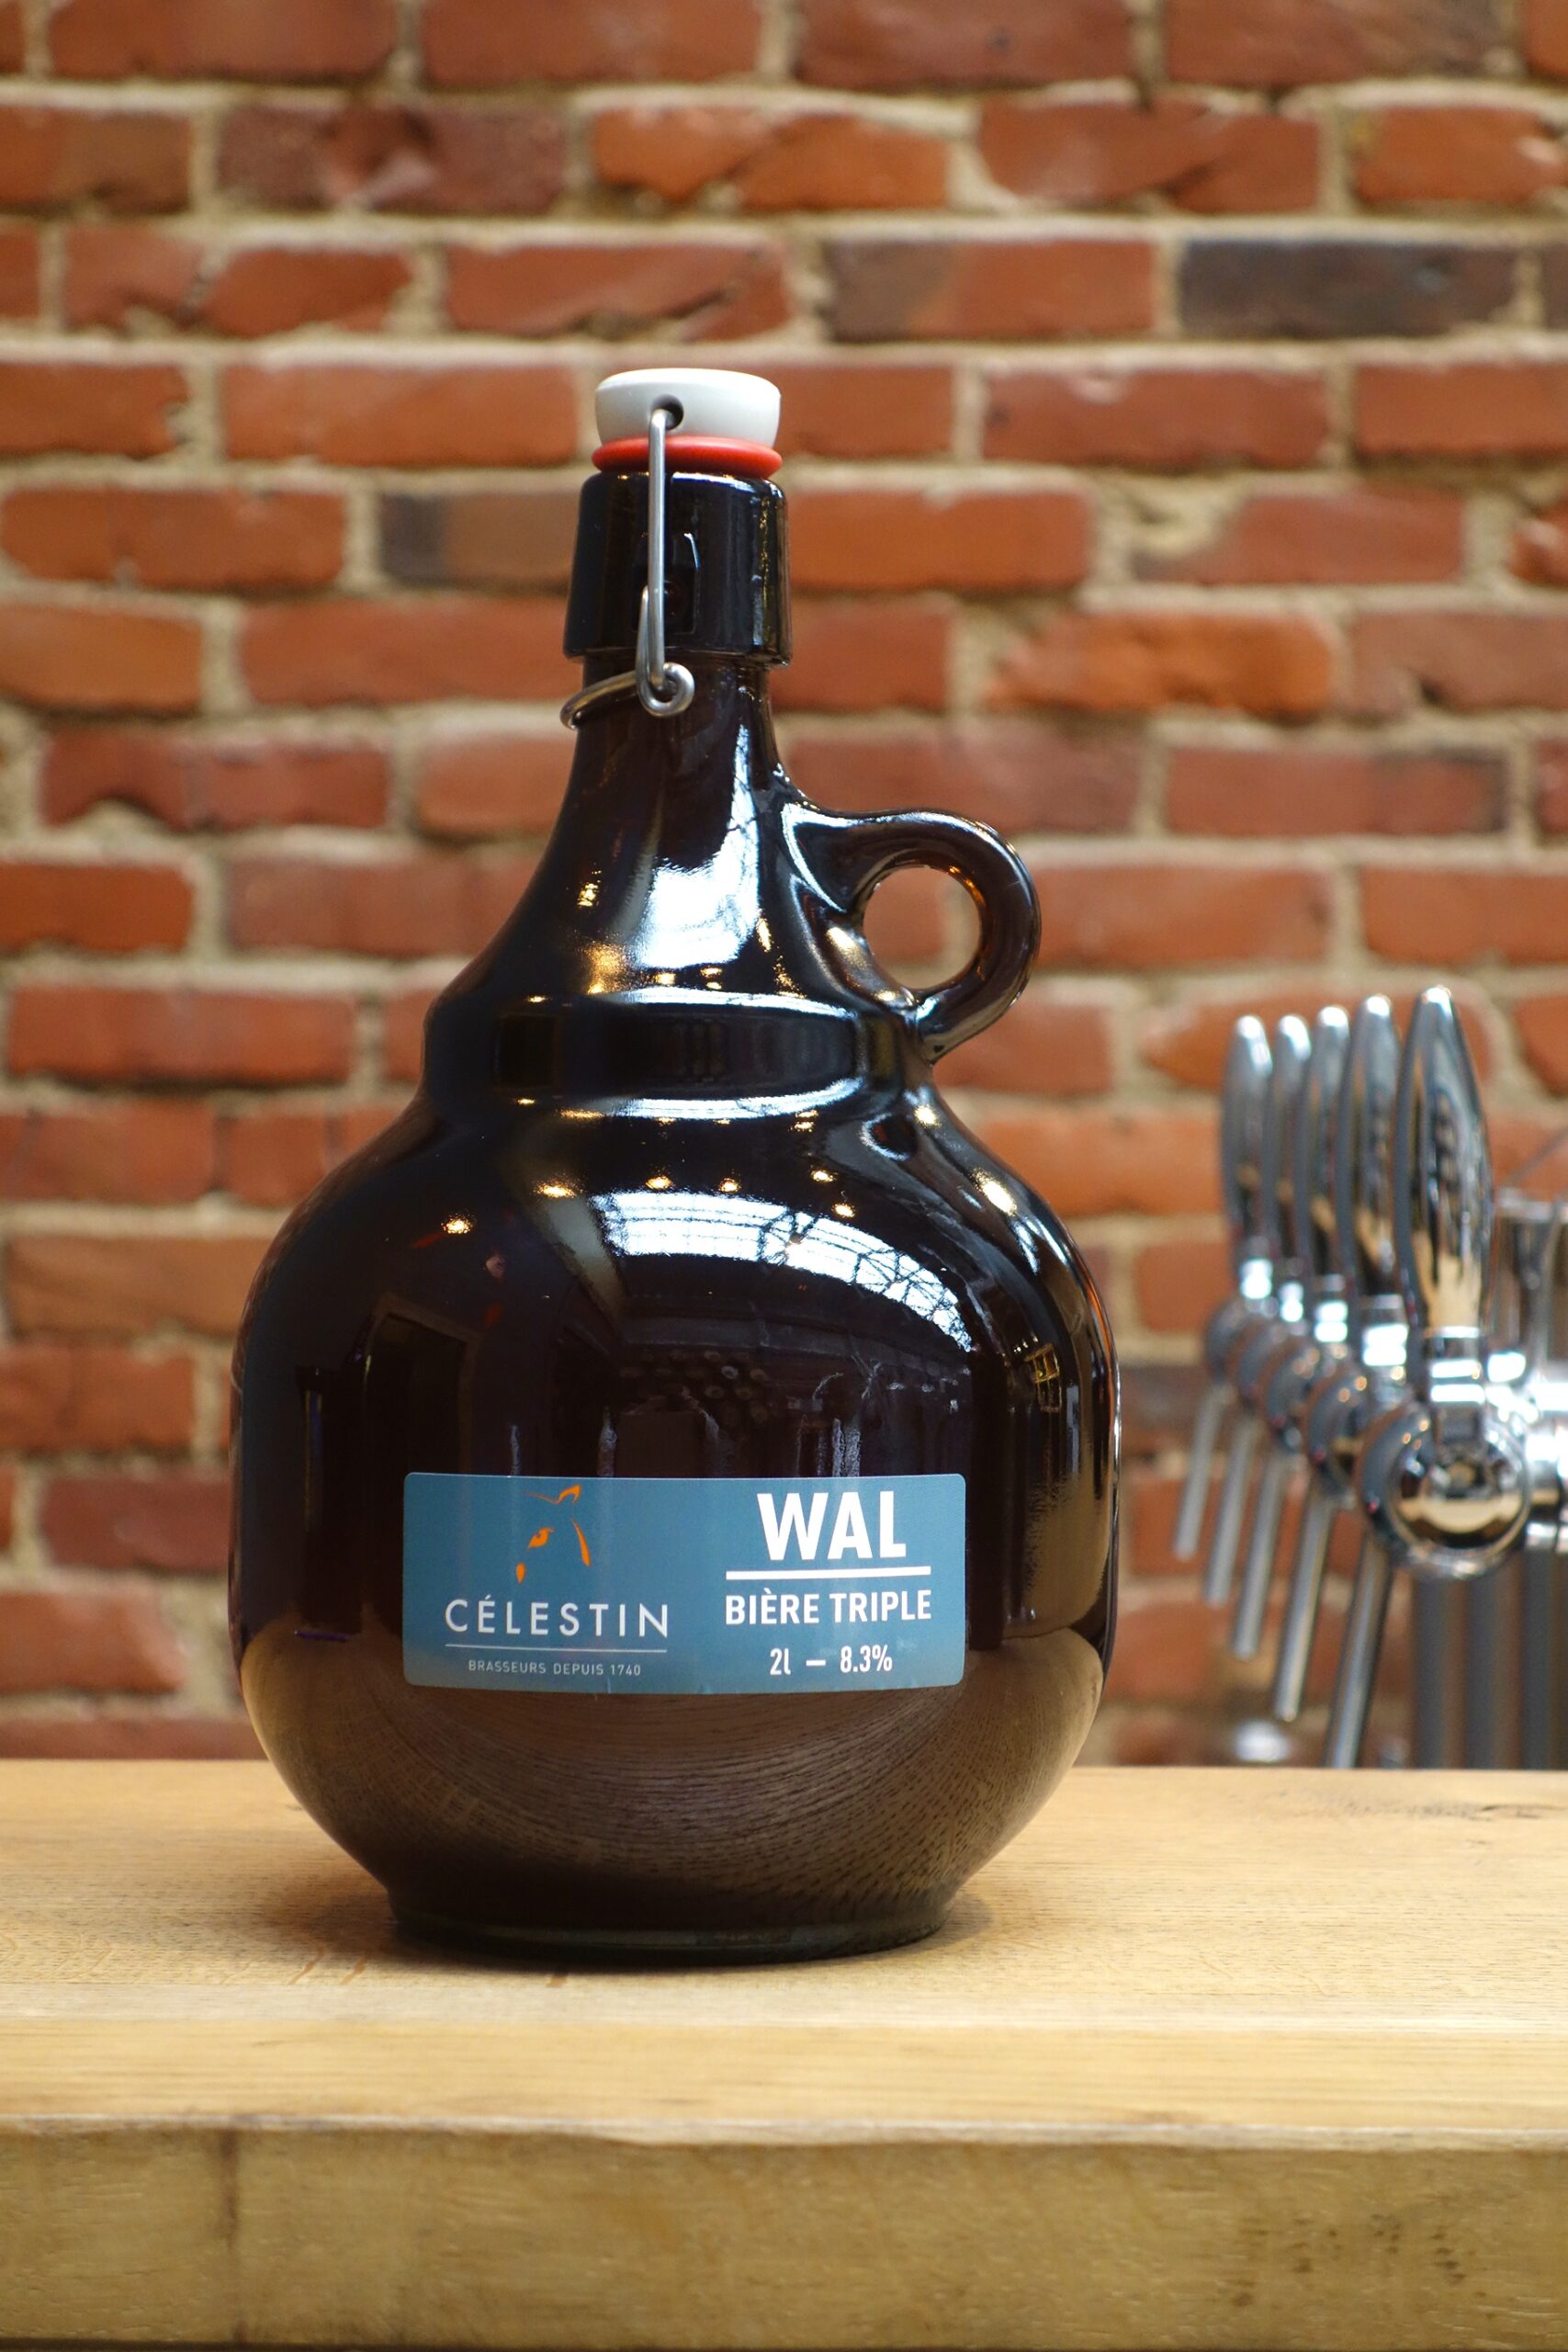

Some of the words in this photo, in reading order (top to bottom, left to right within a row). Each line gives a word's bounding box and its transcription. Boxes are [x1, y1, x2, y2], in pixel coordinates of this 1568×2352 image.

[756, 1490, 907, 1561] WAL
[445, 1594, 668, 1638] CÉLESTIN
[726, 1588, 820, 1625] BIÈRE
[829, 1589, 931, 1623] TRIPLE
[468, 1659, 547, 1674] BRASSEURS
[553, 1663, 604, 1676] DEPUIS
[610, 1664, 641, 1677] 1740
[840, 1644, 894, 1674] 8.3%
